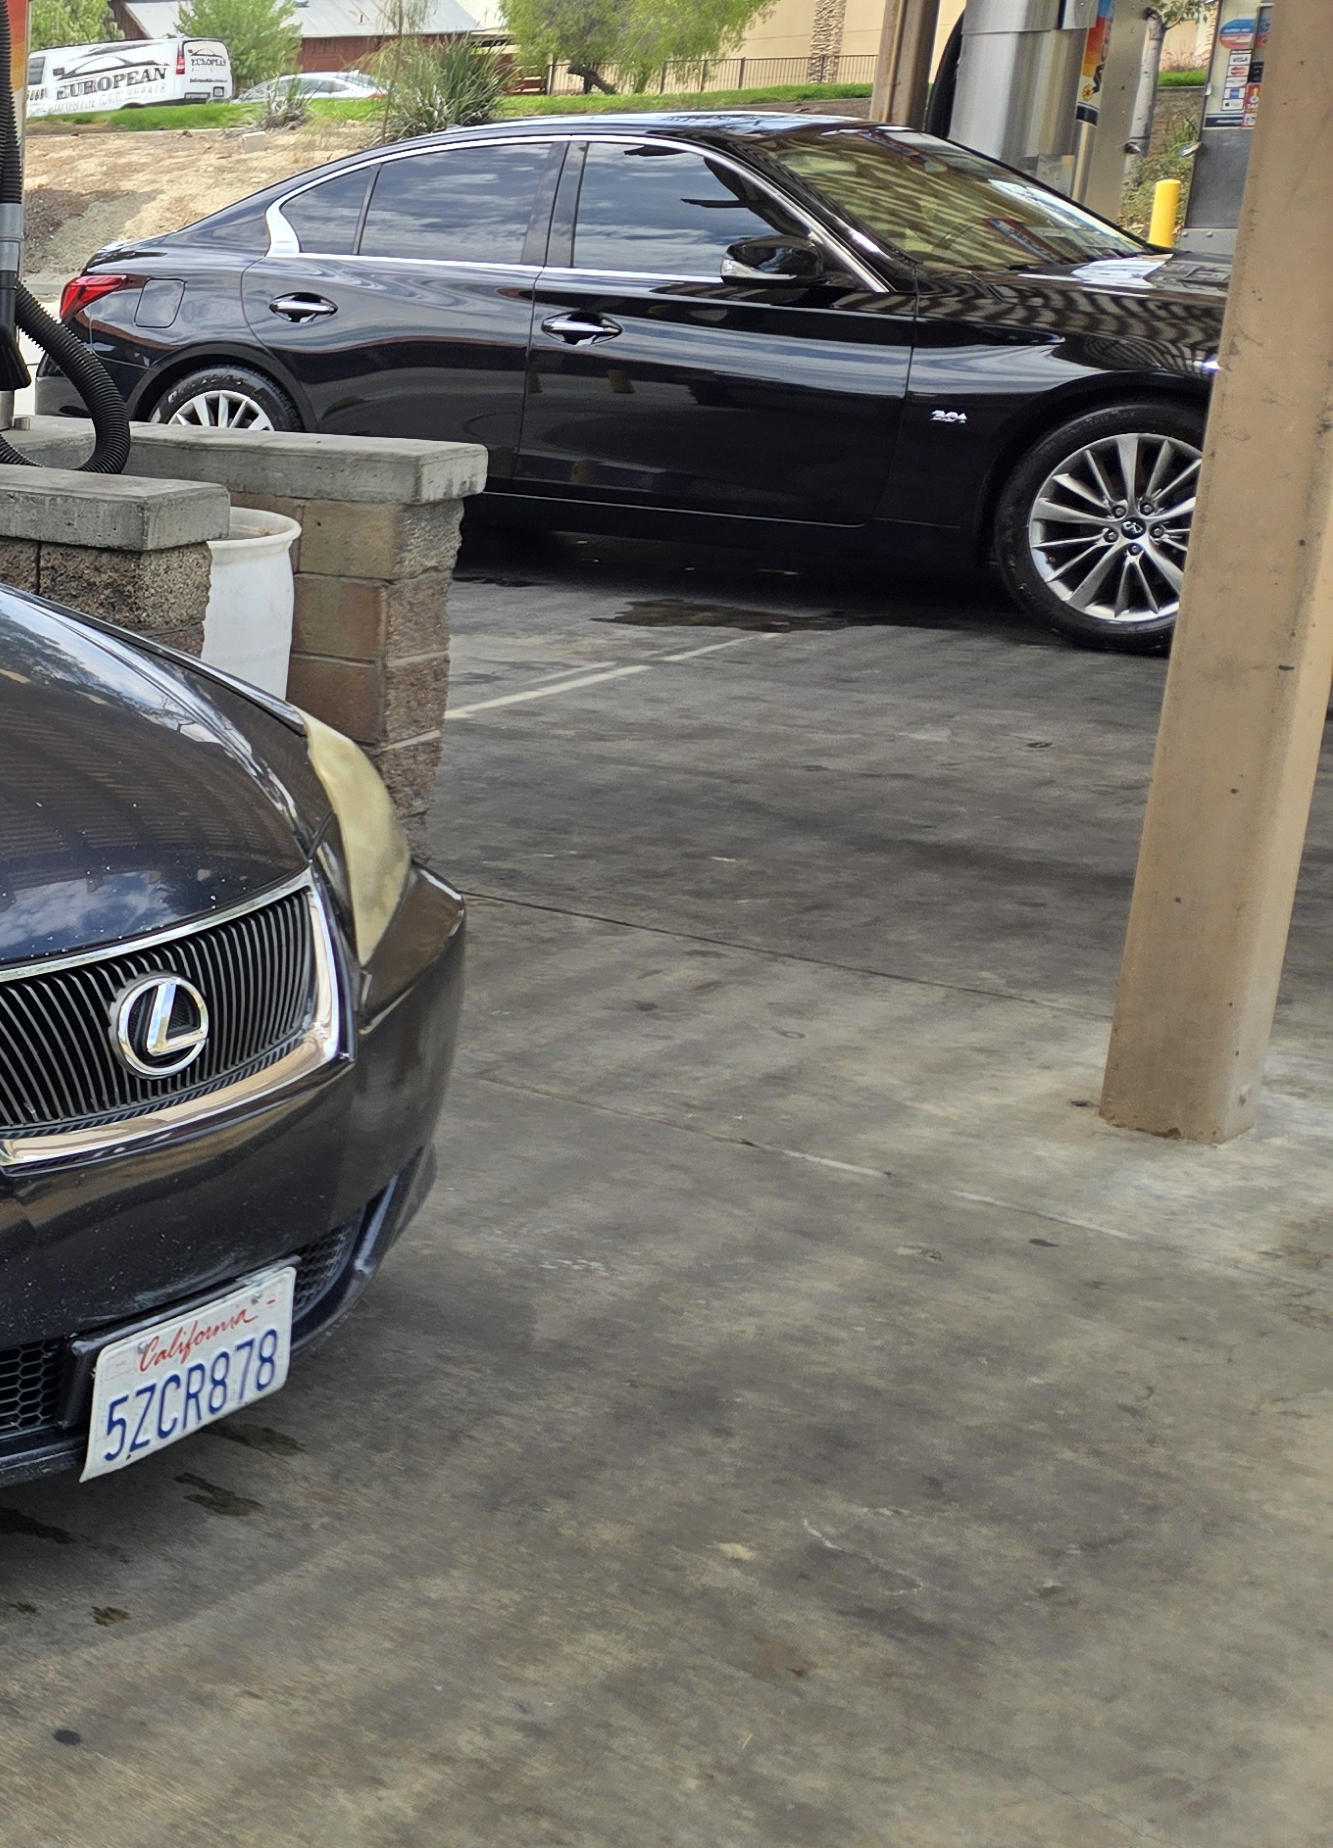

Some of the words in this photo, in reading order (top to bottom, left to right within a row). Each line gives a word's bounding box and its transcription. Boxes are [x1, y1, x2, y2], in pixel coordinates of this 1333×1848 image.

[55, 67, 167, 101] EUROPEAN
[139, 1308, 258, 1372] California
[104, 1328, 278, 1462] 5ZCR878
